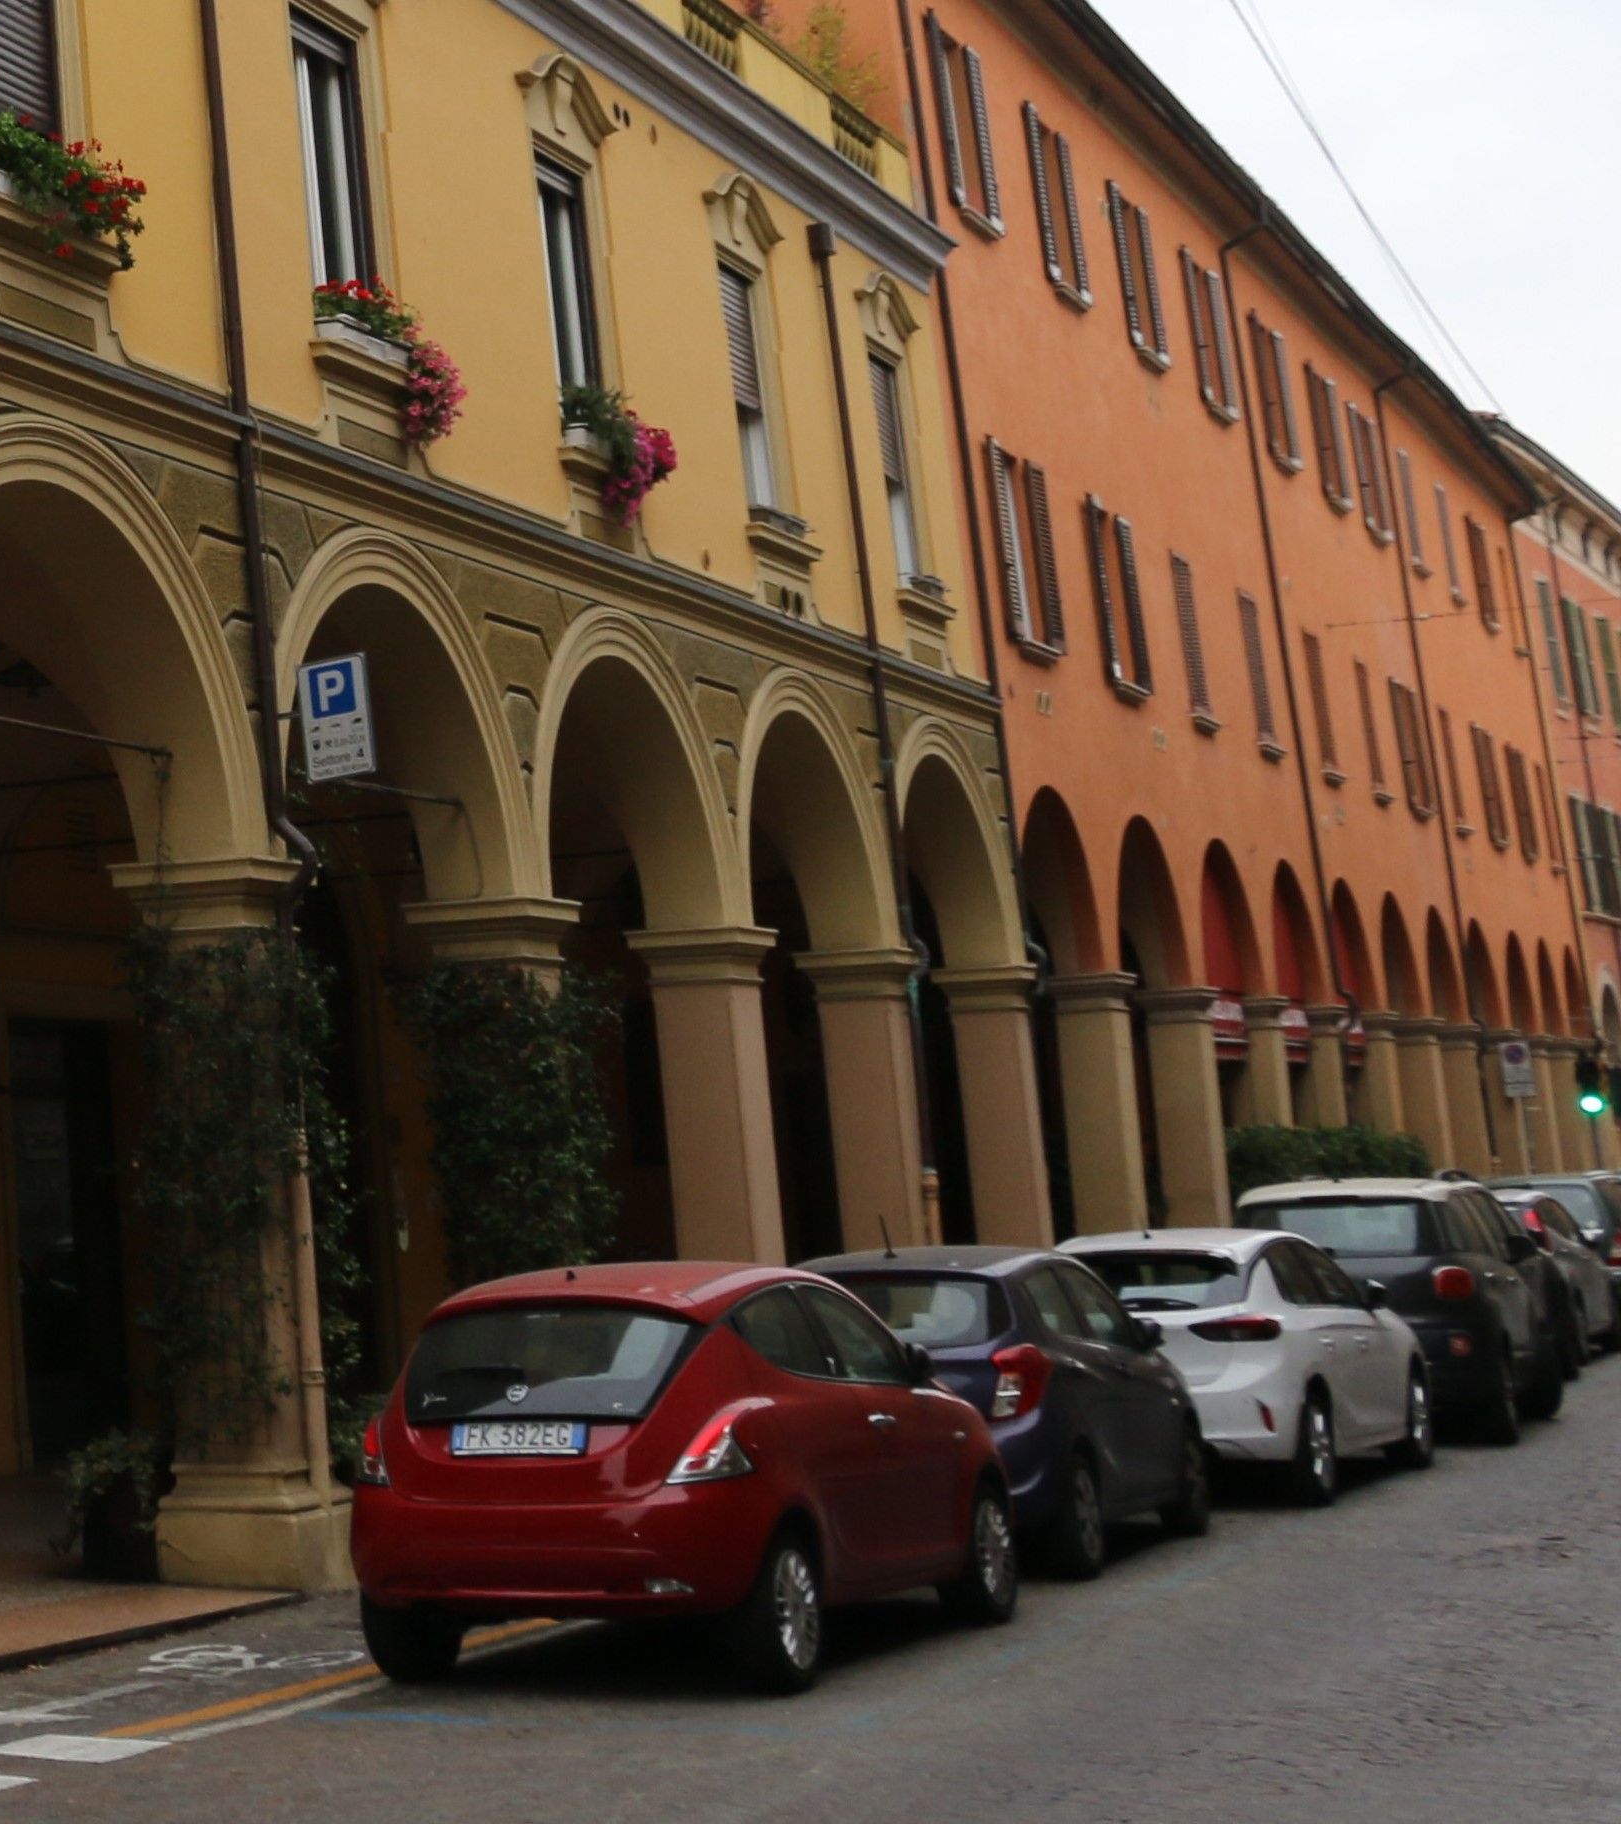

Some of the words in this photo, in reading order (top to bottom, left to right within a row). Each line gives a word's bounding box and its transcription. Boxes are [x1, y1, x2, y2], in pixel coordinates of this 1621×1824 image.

[317, 669, 345, 712] P
[466, 1422, 492, 1447] FK
[500, 1422, 571, 1447] 382EG
